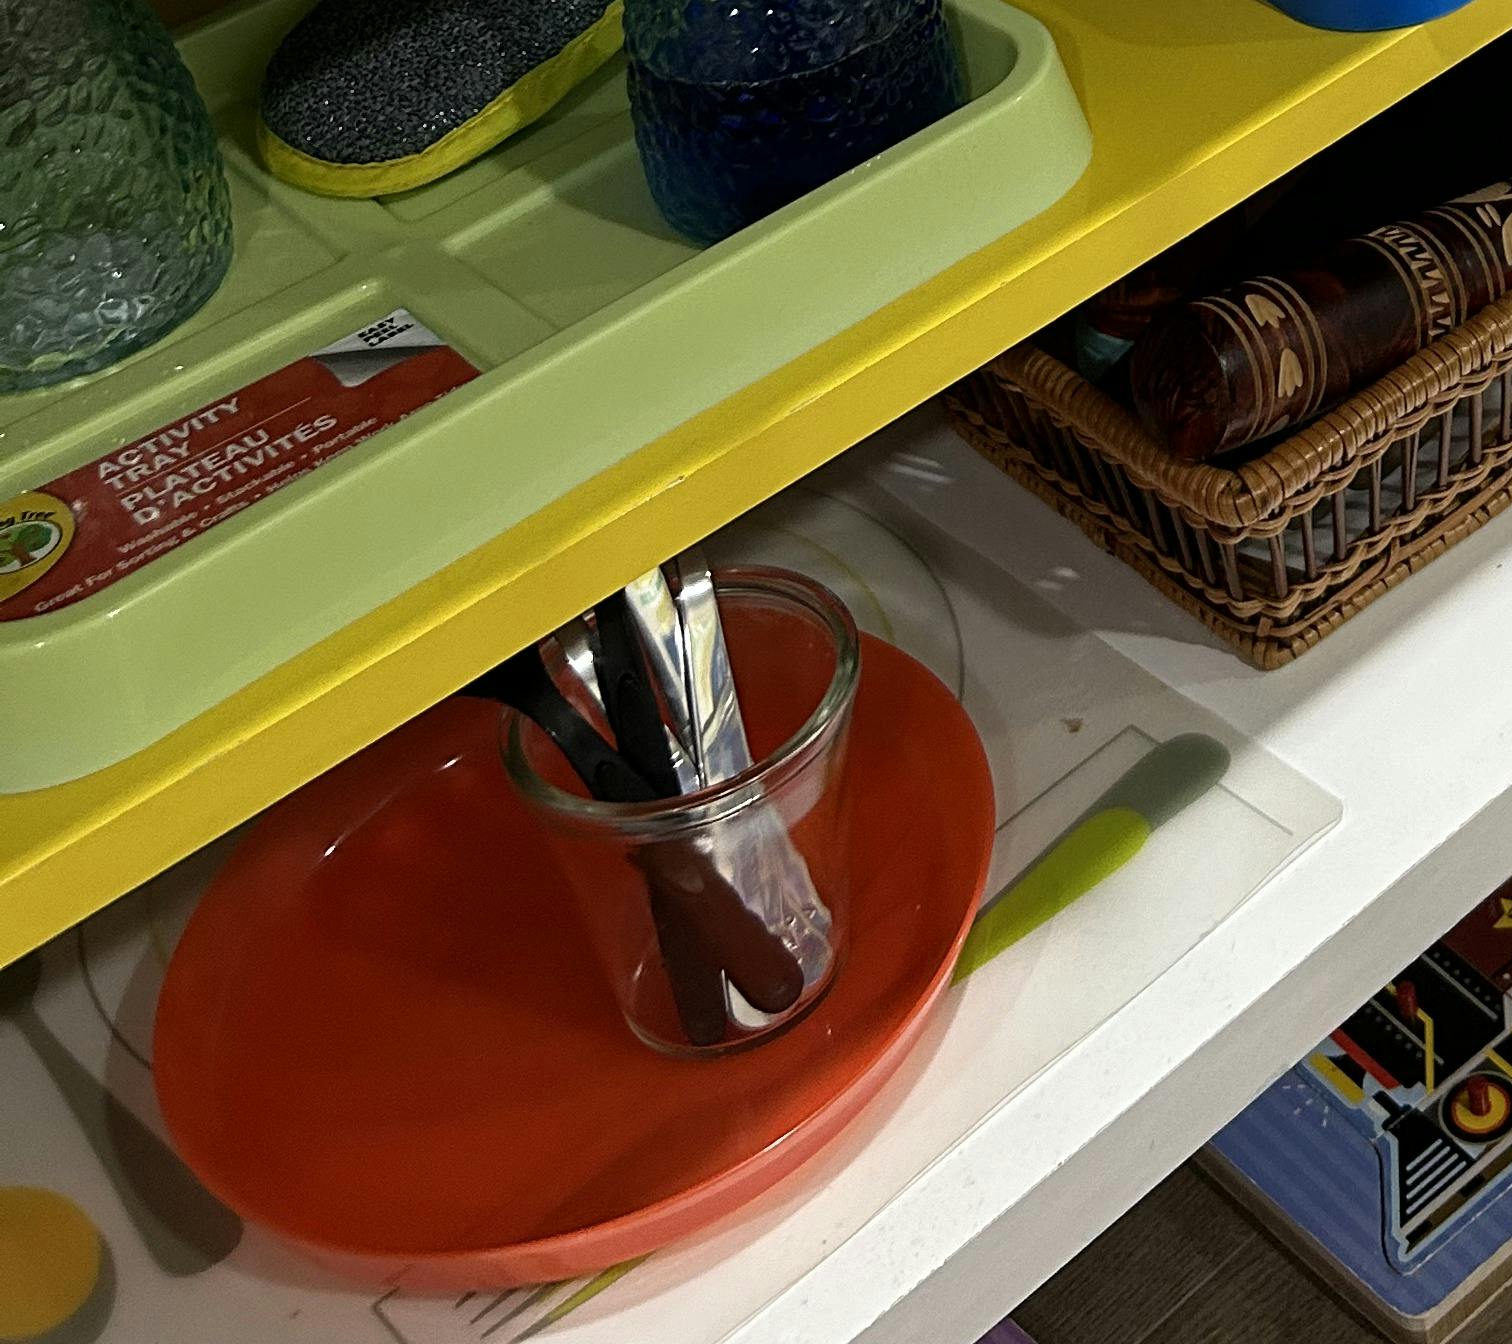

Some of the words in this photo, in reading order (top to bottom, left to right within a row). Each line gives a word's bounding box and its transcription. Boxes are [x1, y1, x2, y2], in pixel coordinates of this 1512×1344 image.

[358, 317, 394, 338] EASY
[363, 325, 398, 343] PEEL
[368, 323, 415, 347] LABEL
[99, 397, 239, 479] ACTIVITY
[104, 440, 189, 490] TRAY
[121, 428, 270, 511] PLATEAU
[133, 414, 338, 526] D'ACTIVITÉS
[117, 512, 199, 553] Washable
[216, 461, 296, 504] Stackable
[312, 417, 377, 454] Portable
[35, 584, 84, 612] Great
[85, 568, 113, 587] For
[116, 536, 181, 570] Sorting
[200, 501, 250, 528] Crafts
